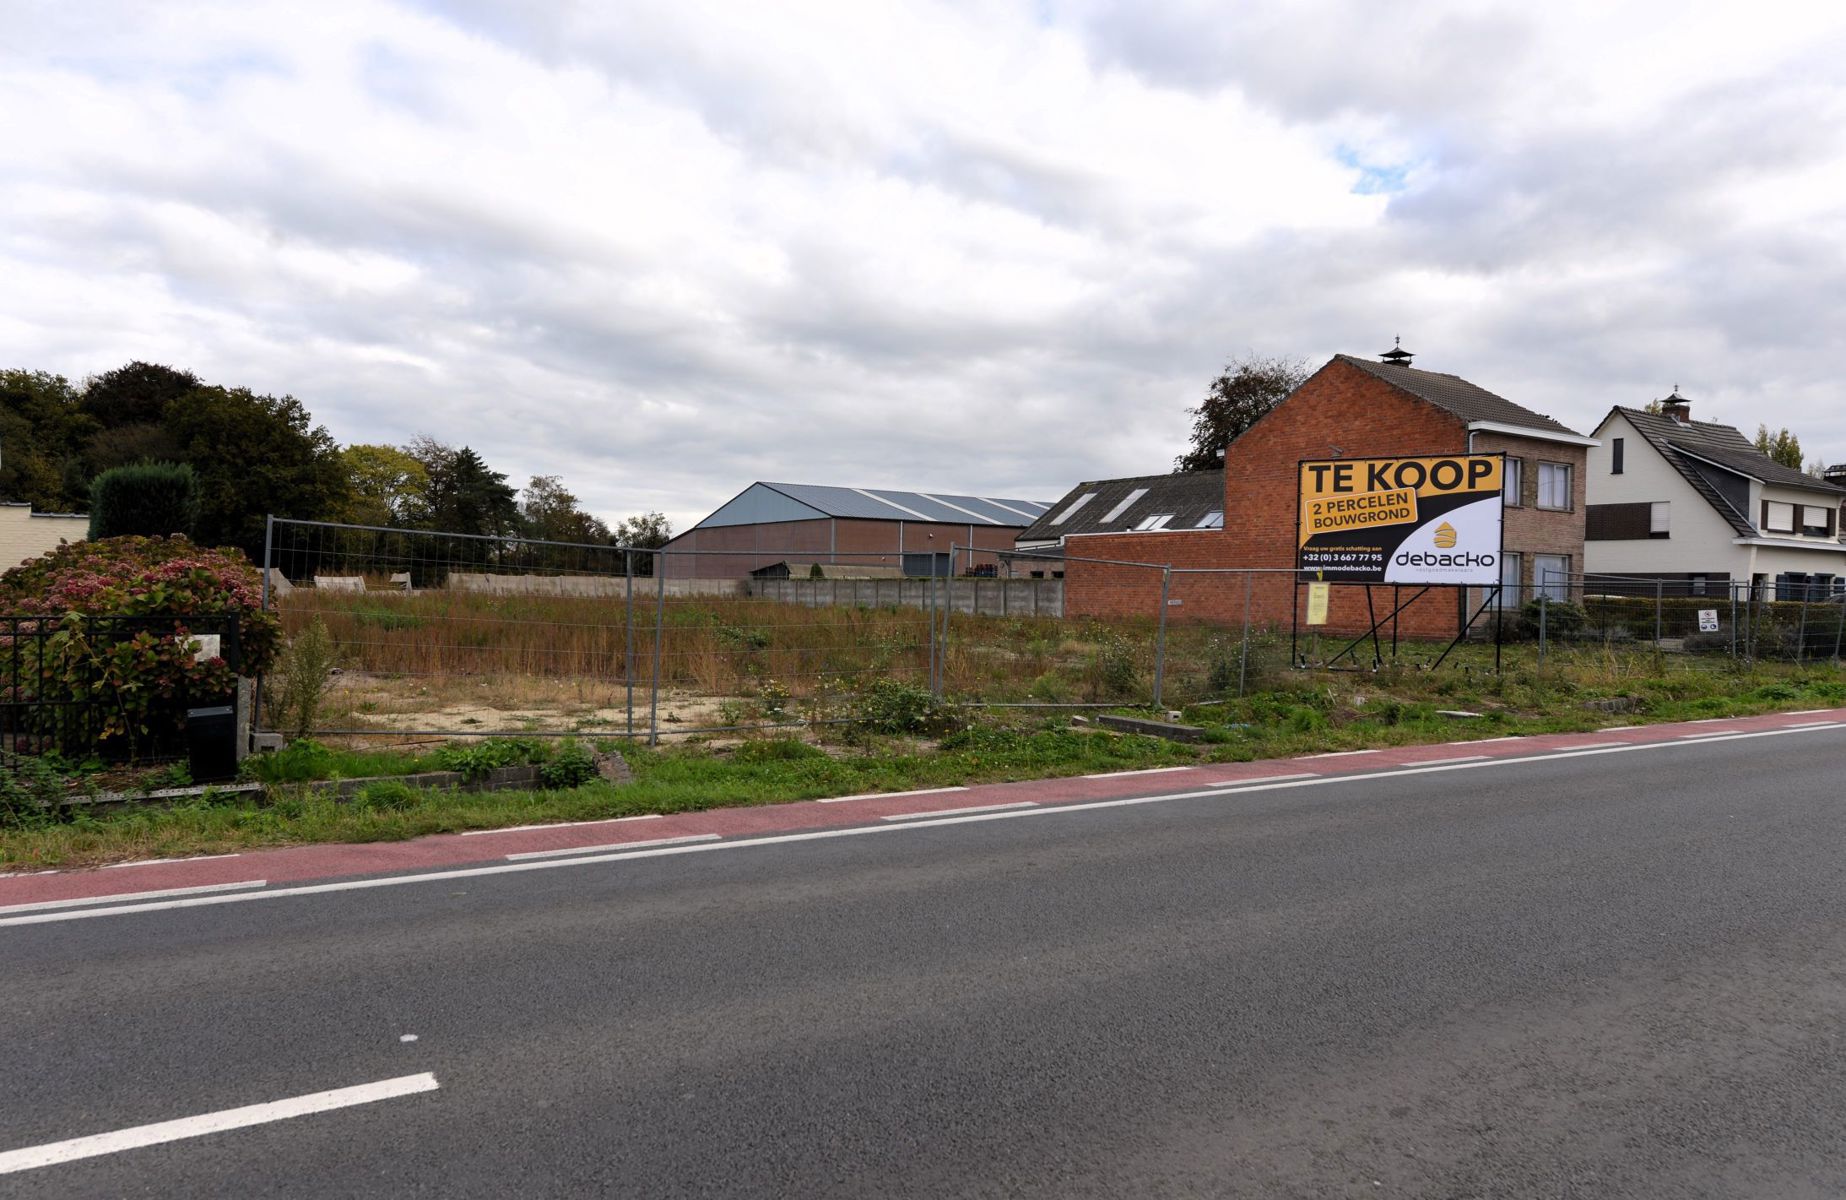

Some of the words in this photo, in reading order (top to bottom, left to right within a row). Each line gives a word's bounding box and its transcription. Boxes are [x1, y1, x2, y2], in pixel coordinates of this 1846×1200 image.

[1309, 464, 1354, 493] TE
[1367, 459, 1493, 492] KOOP
[1313, 503, 1322, 515] 2
[1327, 492, 1409, 513] PERCELEN
[1314, 507, 1410, 529] BOUWGROND
[1320, 554, 1332, 562] (0)
[1395, 551, 1495, 567] debacko
